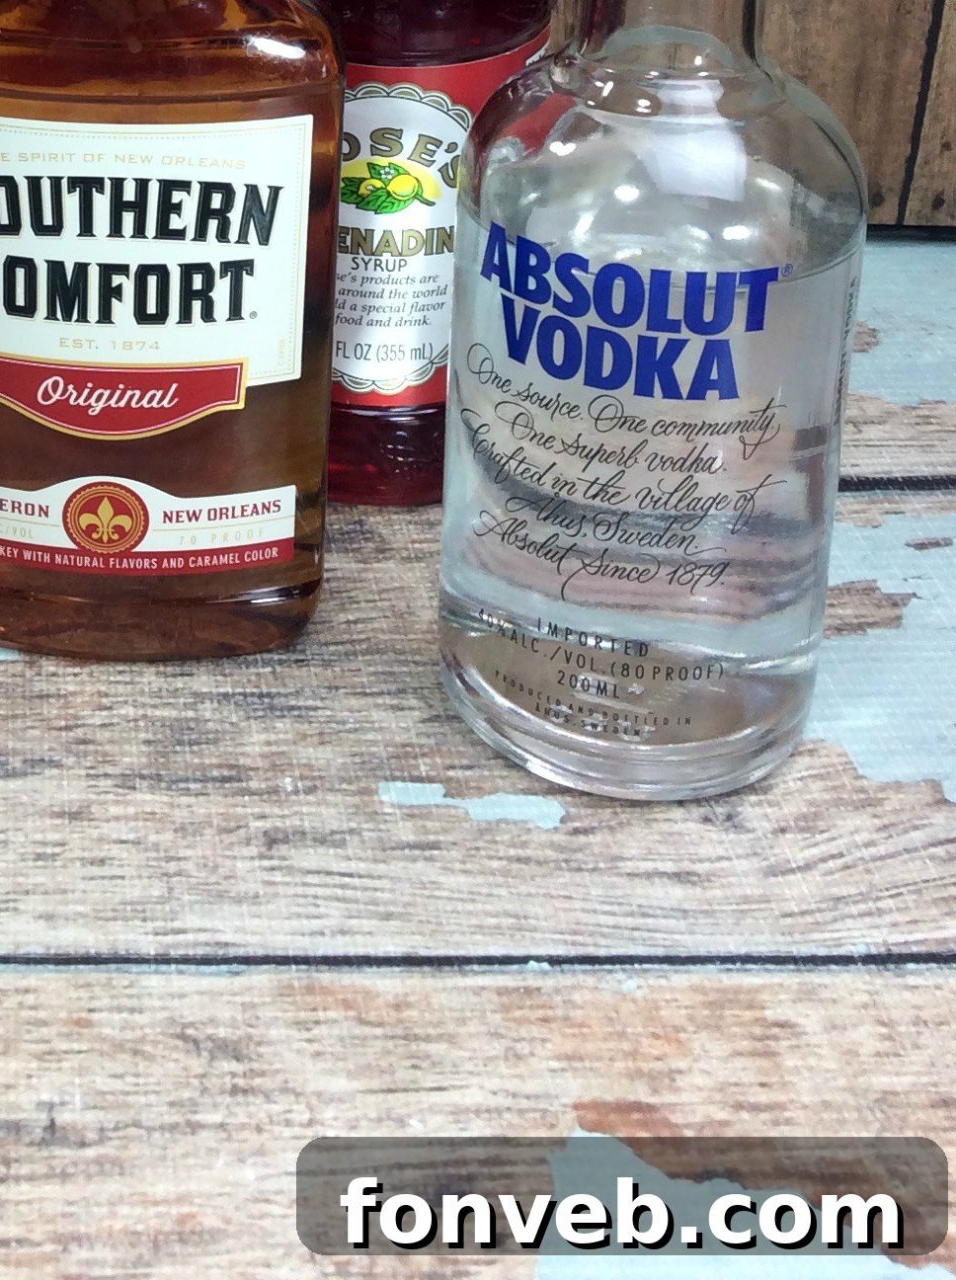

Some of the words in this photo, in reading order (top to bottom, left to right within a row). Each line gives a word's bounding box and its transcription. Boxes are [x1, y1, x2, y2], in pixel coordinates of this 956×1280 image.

[18, 152, 76, 163] SPIRIT
[83, 153, 106, 163] OF
[113, 153, 154, 165] NEW
[160, 155, 246, 170] ORLEANS
[341, 127, 461, 189] OSE'S
[337, 225, 455, 257] ENADIN
[351, 256, 407, 273] SYRUP
[360, 274, 416, 287] products
[419, 274, 439, 284] are
[480, 220, 779, 336] ABSOLUT
[338, 287, 385, 299] around
[389, 288, 409, 299] the
[412, 284, 448, 299] world
[335, 312, 363, 326] food
[366, 316, 391, 327] and
[350, 303, 357, 311] a
[361, 303, 405, 316] special
[409, 301, 446, 317] flavor
[59, 337, 99, 350] EST.
[111, 340, 161, 351] 1874
[336, 340, 350, 359] FL
[354, 342, 372, 360] OZ
[376, 344, 406, 363] (355
[500, 292, 740, 401] VODKA
[36, 375, 180, 416] Original
[467, 342, 512, 394] One
[511, 382, 584, 425] source.
[588, 394, 647, 433] One
[495, 401, 556, 450] One
[555, 432, 649, 473] superb
[460, 408, 556, 485] Crafted
[551, 473, 579, 496] in
[577, 470, 632, 505] the
[635, 474, 733, 531] village
[734, 474, 788, 535] of
[162, 509, 203, 524] NEW
[207, 499, 282, 522] ORLEANS
[179, 535, 197, 546] 70
[210, 527, 265, 545] PROOF
[22, 549, 51, 564] WITH
[55, 553, 105, 569] NATURAL
[109, 557, 158, 570] FLAVORS
[162, 557, 185, 569] AND
[189, 552, 241, 568] CARAMEL
[245, 547, 279, 563] COLOR
[473, 510, 592, 575] Absolut
[561, 547, 661, 602] Since
[537, 616, 649, 658] IMPORTED
[652, 662, 724, 681] PROOF)
[557, 670, 620, 699] 200ML
